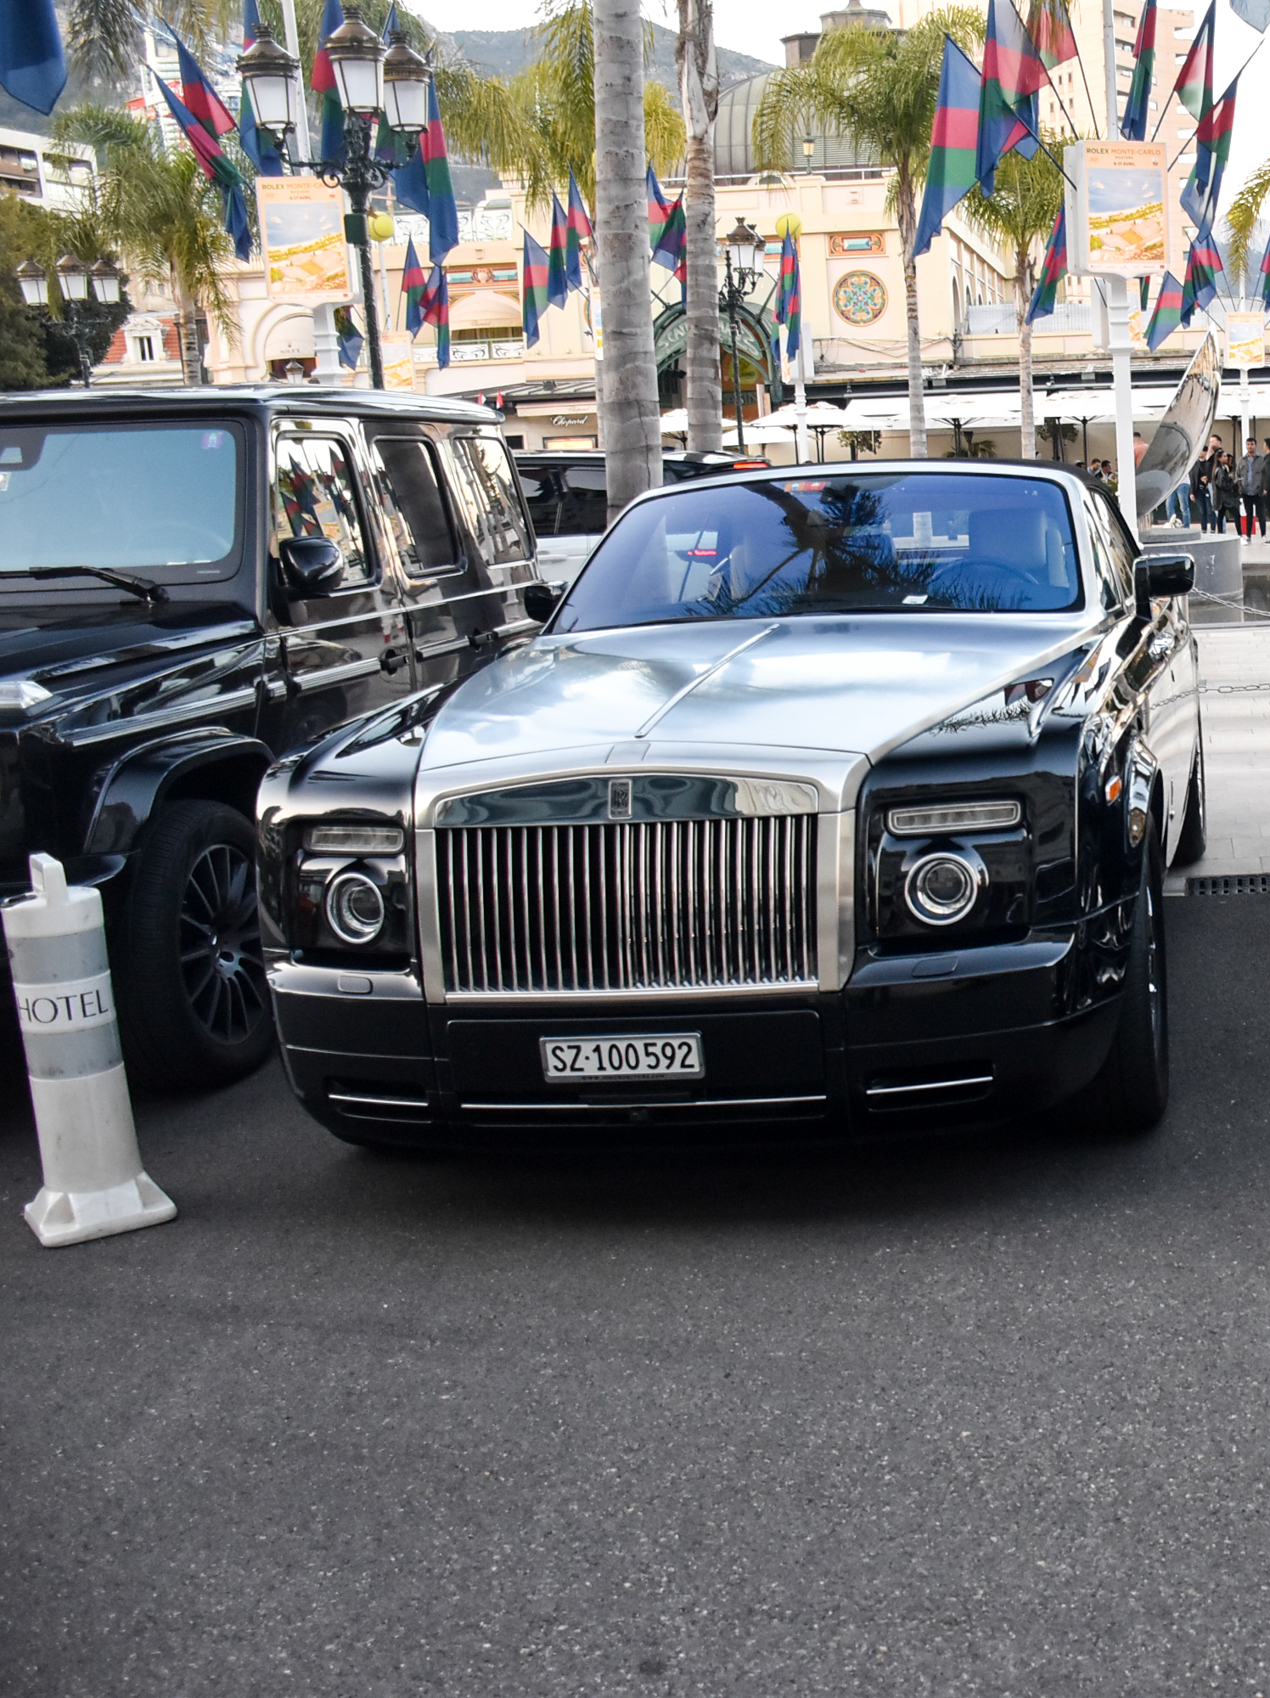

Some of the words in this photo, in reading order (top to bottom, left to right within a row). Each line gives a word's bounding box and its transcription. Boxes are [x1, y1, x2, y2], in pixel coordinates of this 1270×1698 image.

[1086, 147, 1109, 155] ROLEX
[1111, 148, 1161, 156] MONTE-CARLO
[549, 414, 589, 428] Chopard
[16, 988, 109, 1024] HOTEL
